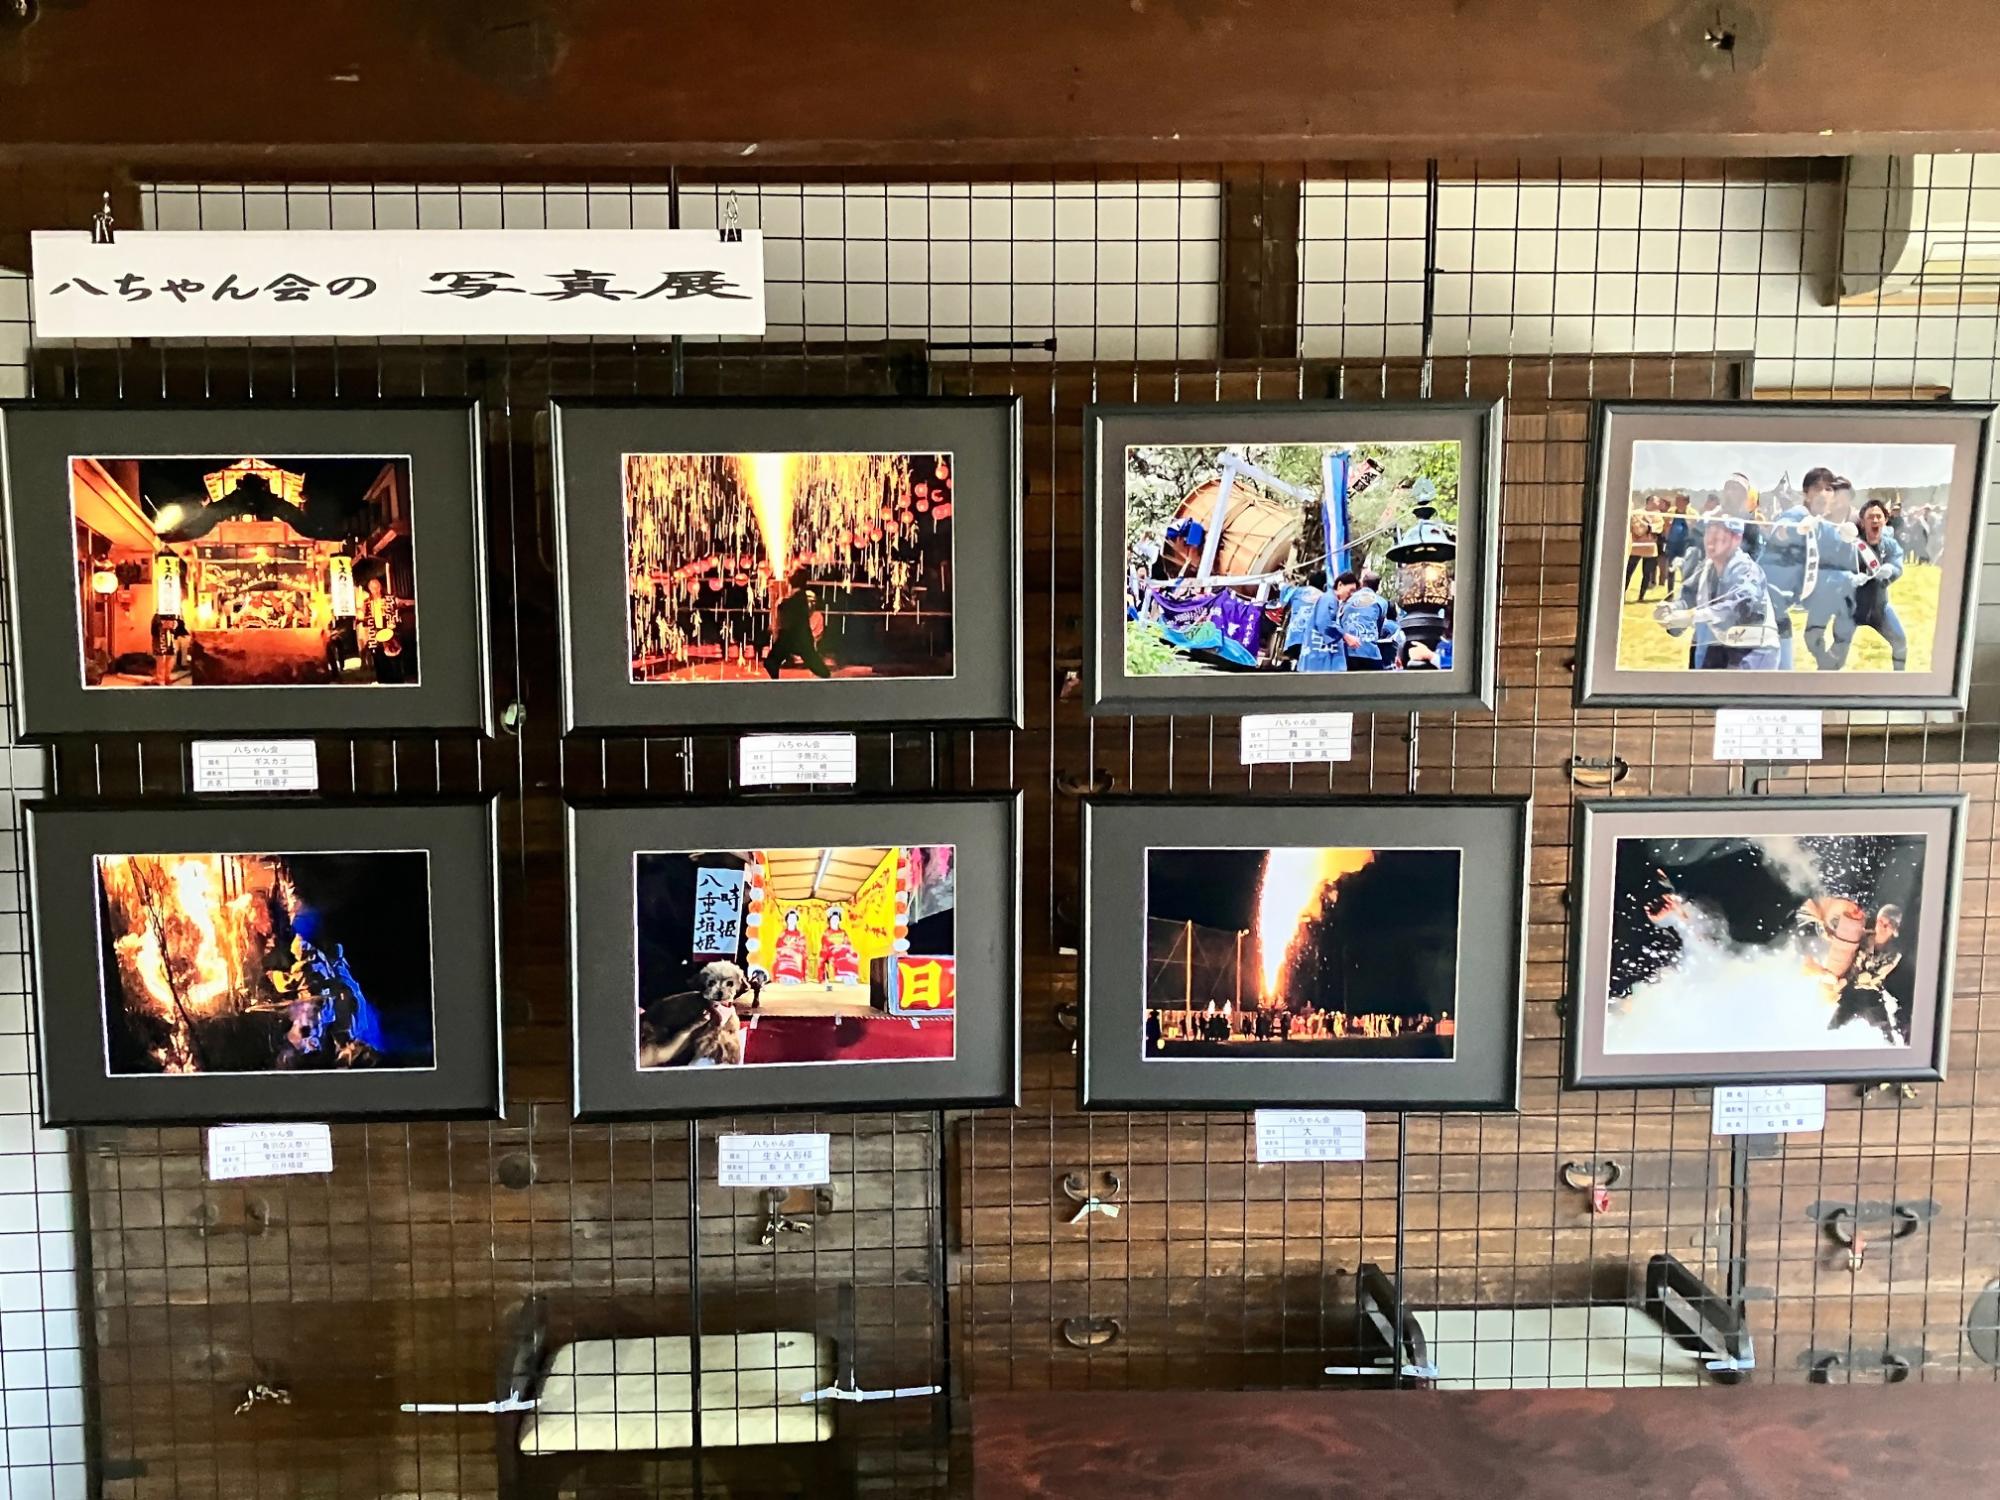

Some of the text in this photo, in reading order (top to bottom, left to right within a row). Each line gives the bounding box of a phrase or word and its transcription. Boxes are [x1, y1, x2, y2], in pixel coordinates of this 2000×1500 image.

[49, 269, 754, 302] 八ちゃん会の 写真展
[233, 745, 279, 754] 八ちゃん会
[778, 740, 821, 749] 八ちゃん会
[694, 873, 724, 951] 八重垣姫
[717, 883, 741, 938] 時姫
[898, 960, 954, 1008] 日
[753, 1139, 795, 1149] 八ちゃん会
